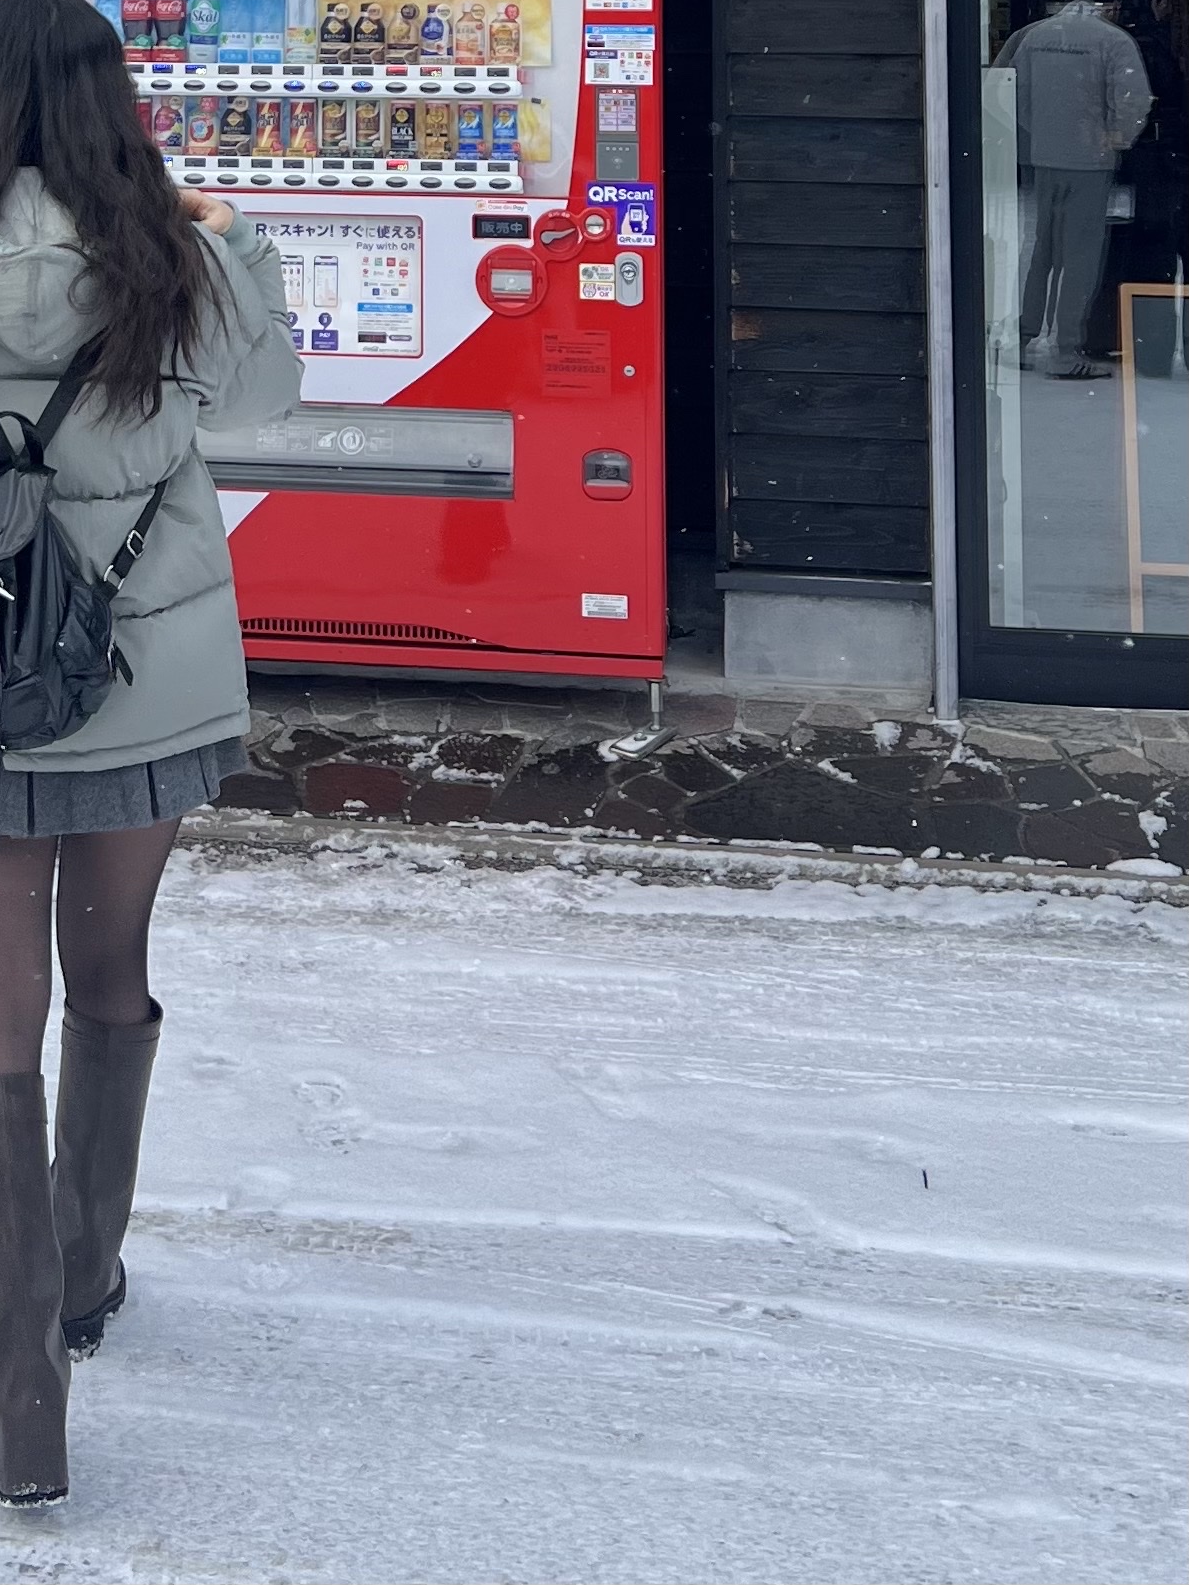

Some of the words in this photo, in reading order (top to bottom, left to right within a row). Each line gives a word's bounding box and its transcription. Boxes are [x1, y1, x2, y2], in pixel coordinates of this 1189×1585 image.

[588, 186, 618, 203] QR
[618, 188, 654, 201] Scan!
[253, 223, 334, 238] Rをスキャン!
[340, 224, 422, 240] すぐに使える!
[481, 221, 523, 234] 販売中
[357, 242, 375, 252] Pay
[376, 242, 398, 251] with
[400, 243, 415, 251] QR
